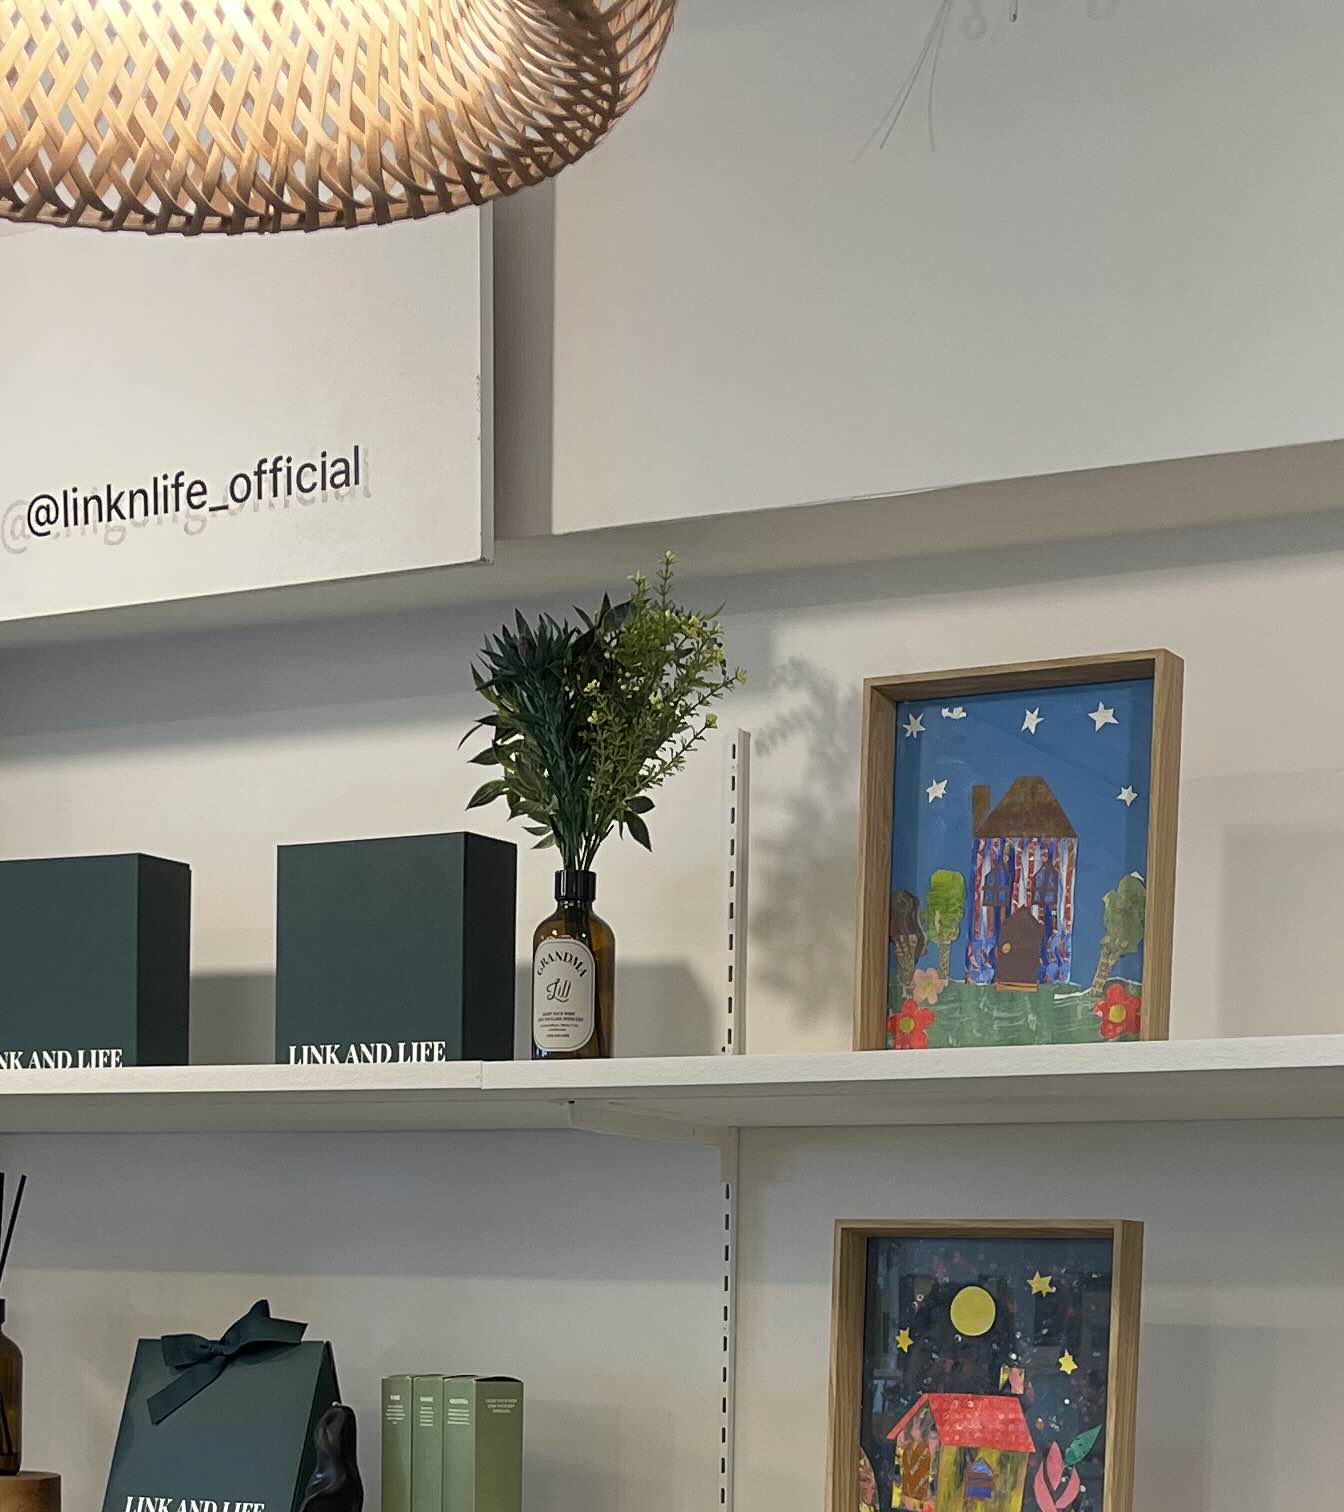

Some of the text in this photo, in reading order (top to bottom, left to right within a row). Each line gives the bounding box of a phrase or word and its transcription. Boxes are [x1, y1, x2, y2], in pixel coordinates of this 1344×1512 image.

[26, 444, 360, 538] @linknlife_official
[537, 951, 588, 977] GRANDMA
[28, 1050, 73, 1069] AND
[76, 1048, 123, 1068] LIFE
[288, 1041, 446, 1065] LINK AND LIFE
